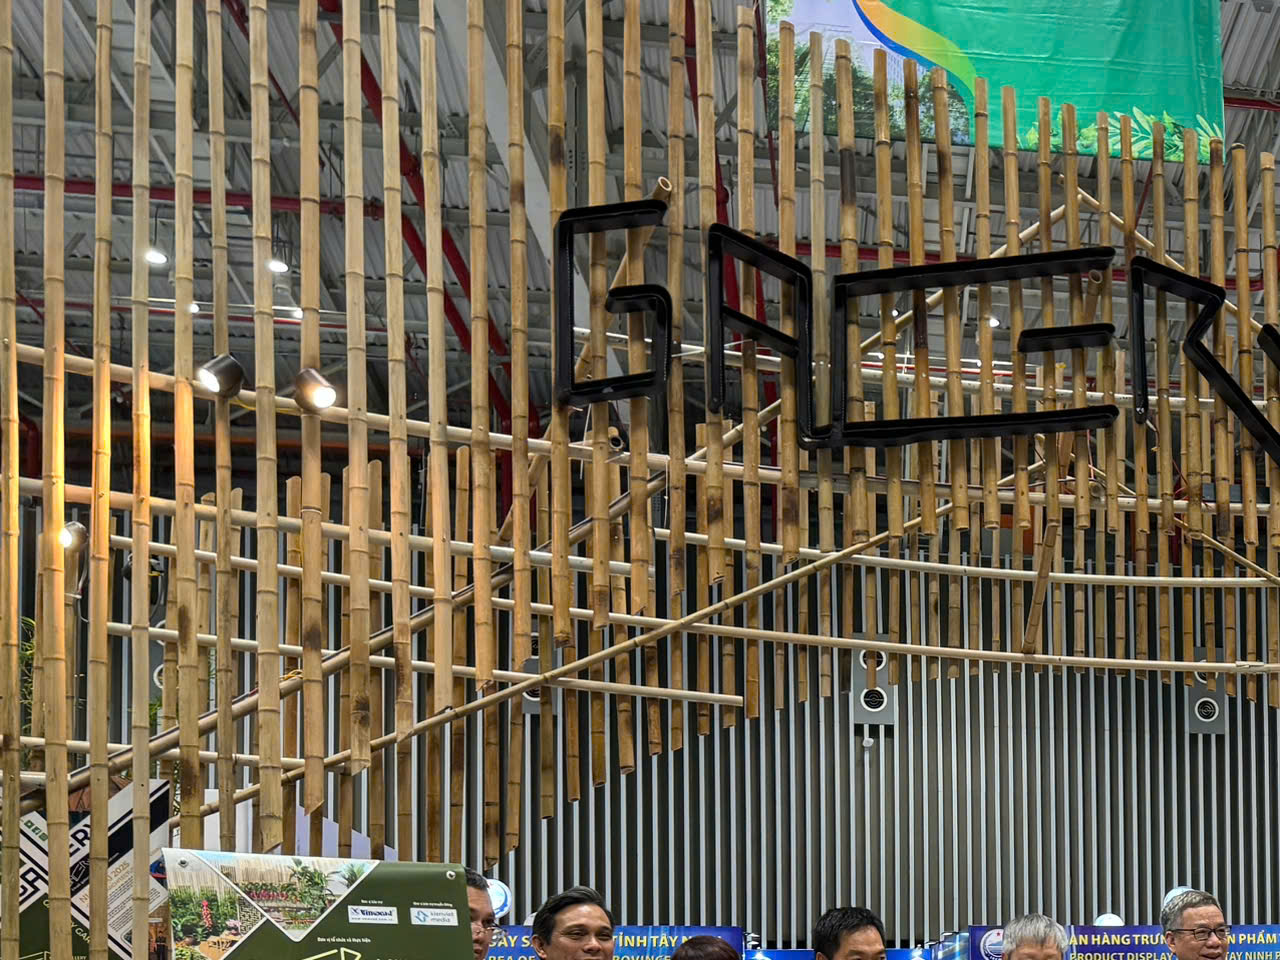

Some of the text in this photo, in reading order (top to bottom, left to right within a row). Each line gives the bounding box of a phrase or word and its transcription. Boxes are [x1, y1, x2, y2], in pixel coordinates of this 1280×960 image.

[1092, 932, 1131, 945] HÀNG
[1133, 933, 1167, 945] TRƯN
[1239, 929, 1277, 944] PHẨM
[1245, 951, 1273, 960] NINH
